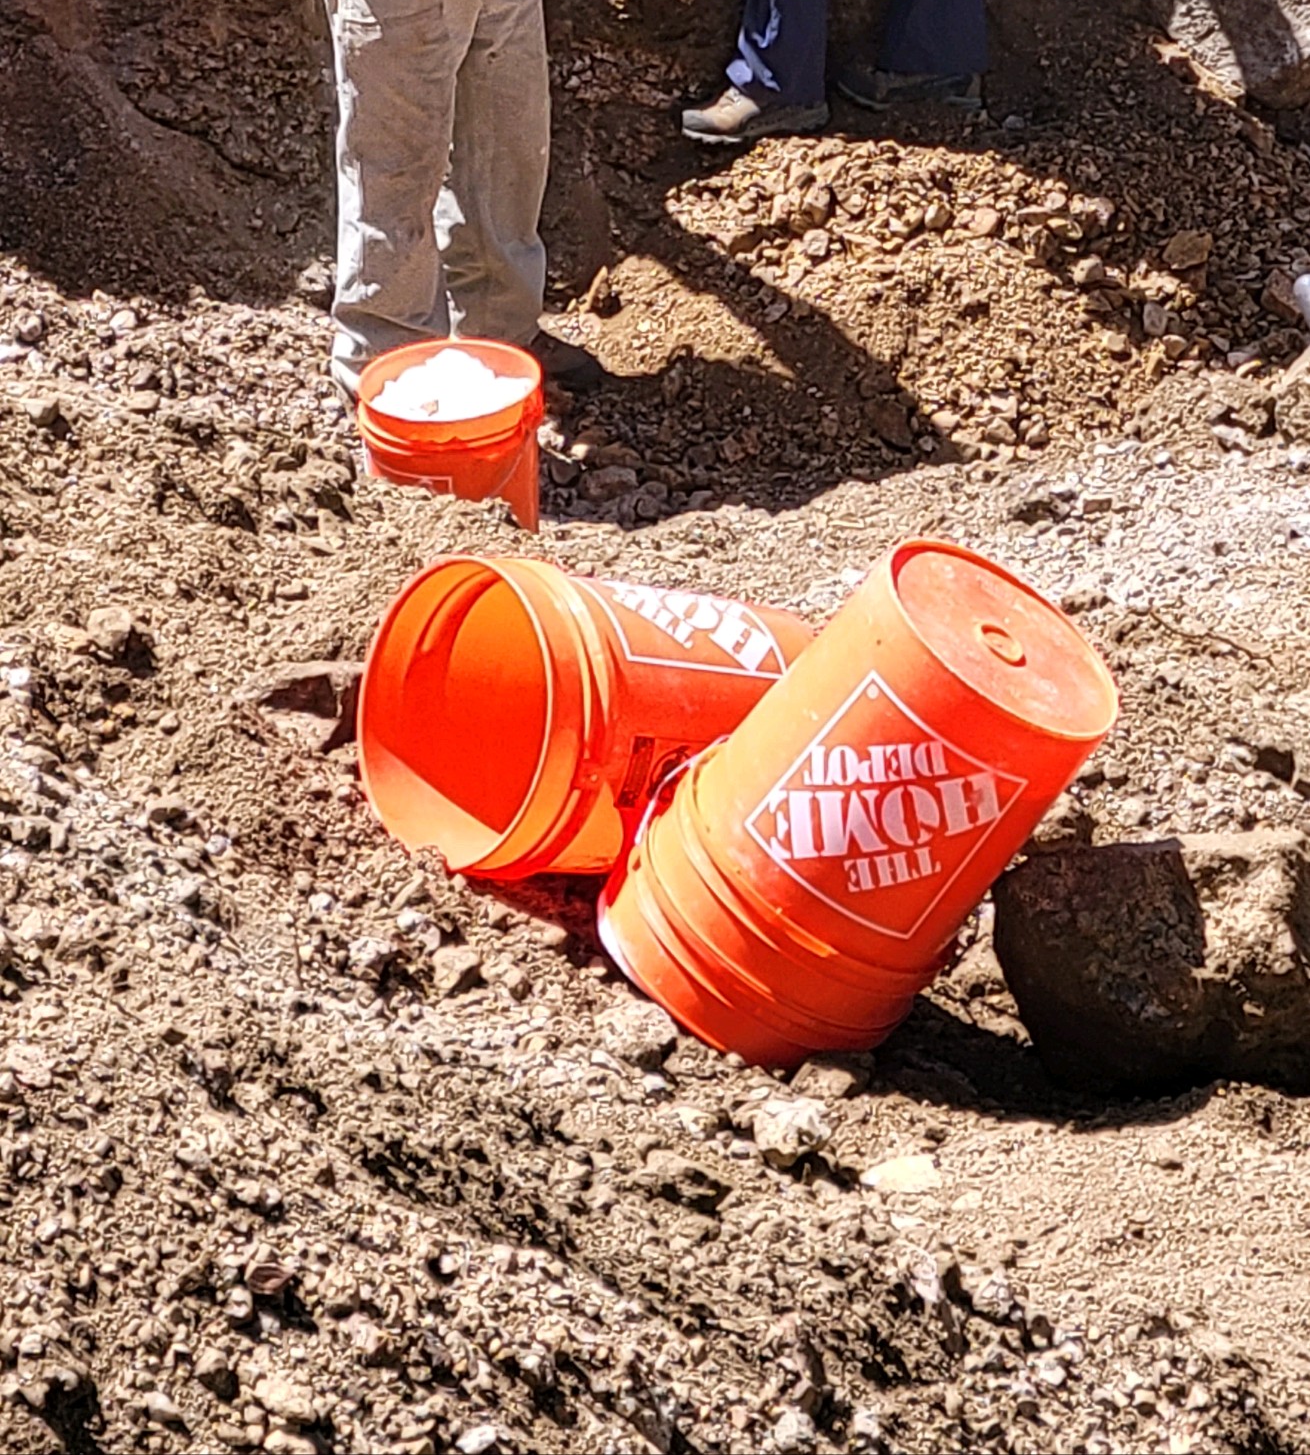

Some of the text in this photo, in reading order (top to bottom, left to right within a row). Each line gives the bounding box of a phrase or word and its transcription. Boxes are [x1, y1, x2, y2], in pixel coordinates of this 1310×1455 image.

[803, 741, 949, 786] DEPOT
[766, 771, 1000, 860] HOME
[844, 847, 942, 893] THE
